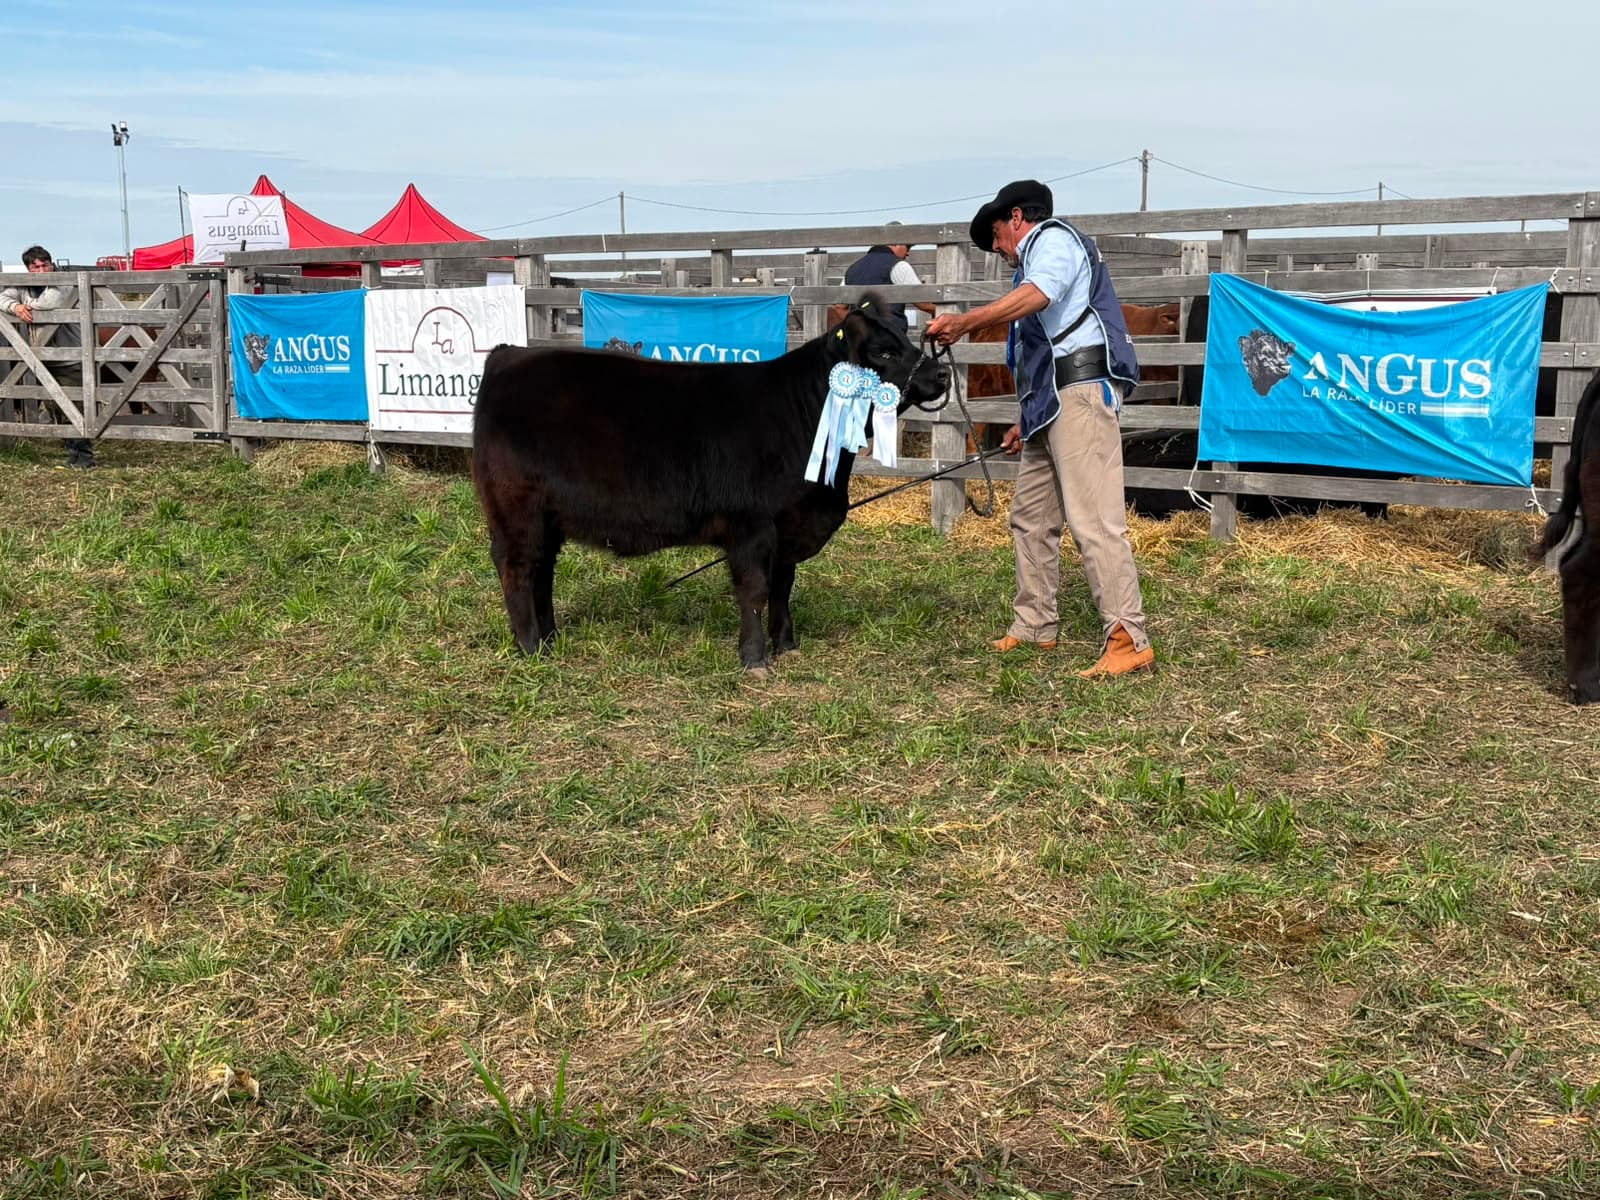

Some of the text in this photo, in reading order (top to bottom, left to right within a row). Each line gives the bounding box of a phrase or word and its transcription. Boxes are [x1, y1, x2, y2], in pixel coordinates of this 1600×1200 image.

[274, 333, 350, 362] ANGUS
[272, 365, 283, 375] LA
[285, 364, 303, 374] RAZA
[1303, 351, 1492, 399] ANGUS
[378, 363, 481, 406] Limang
[1302, 385, 1321, 399] LA
